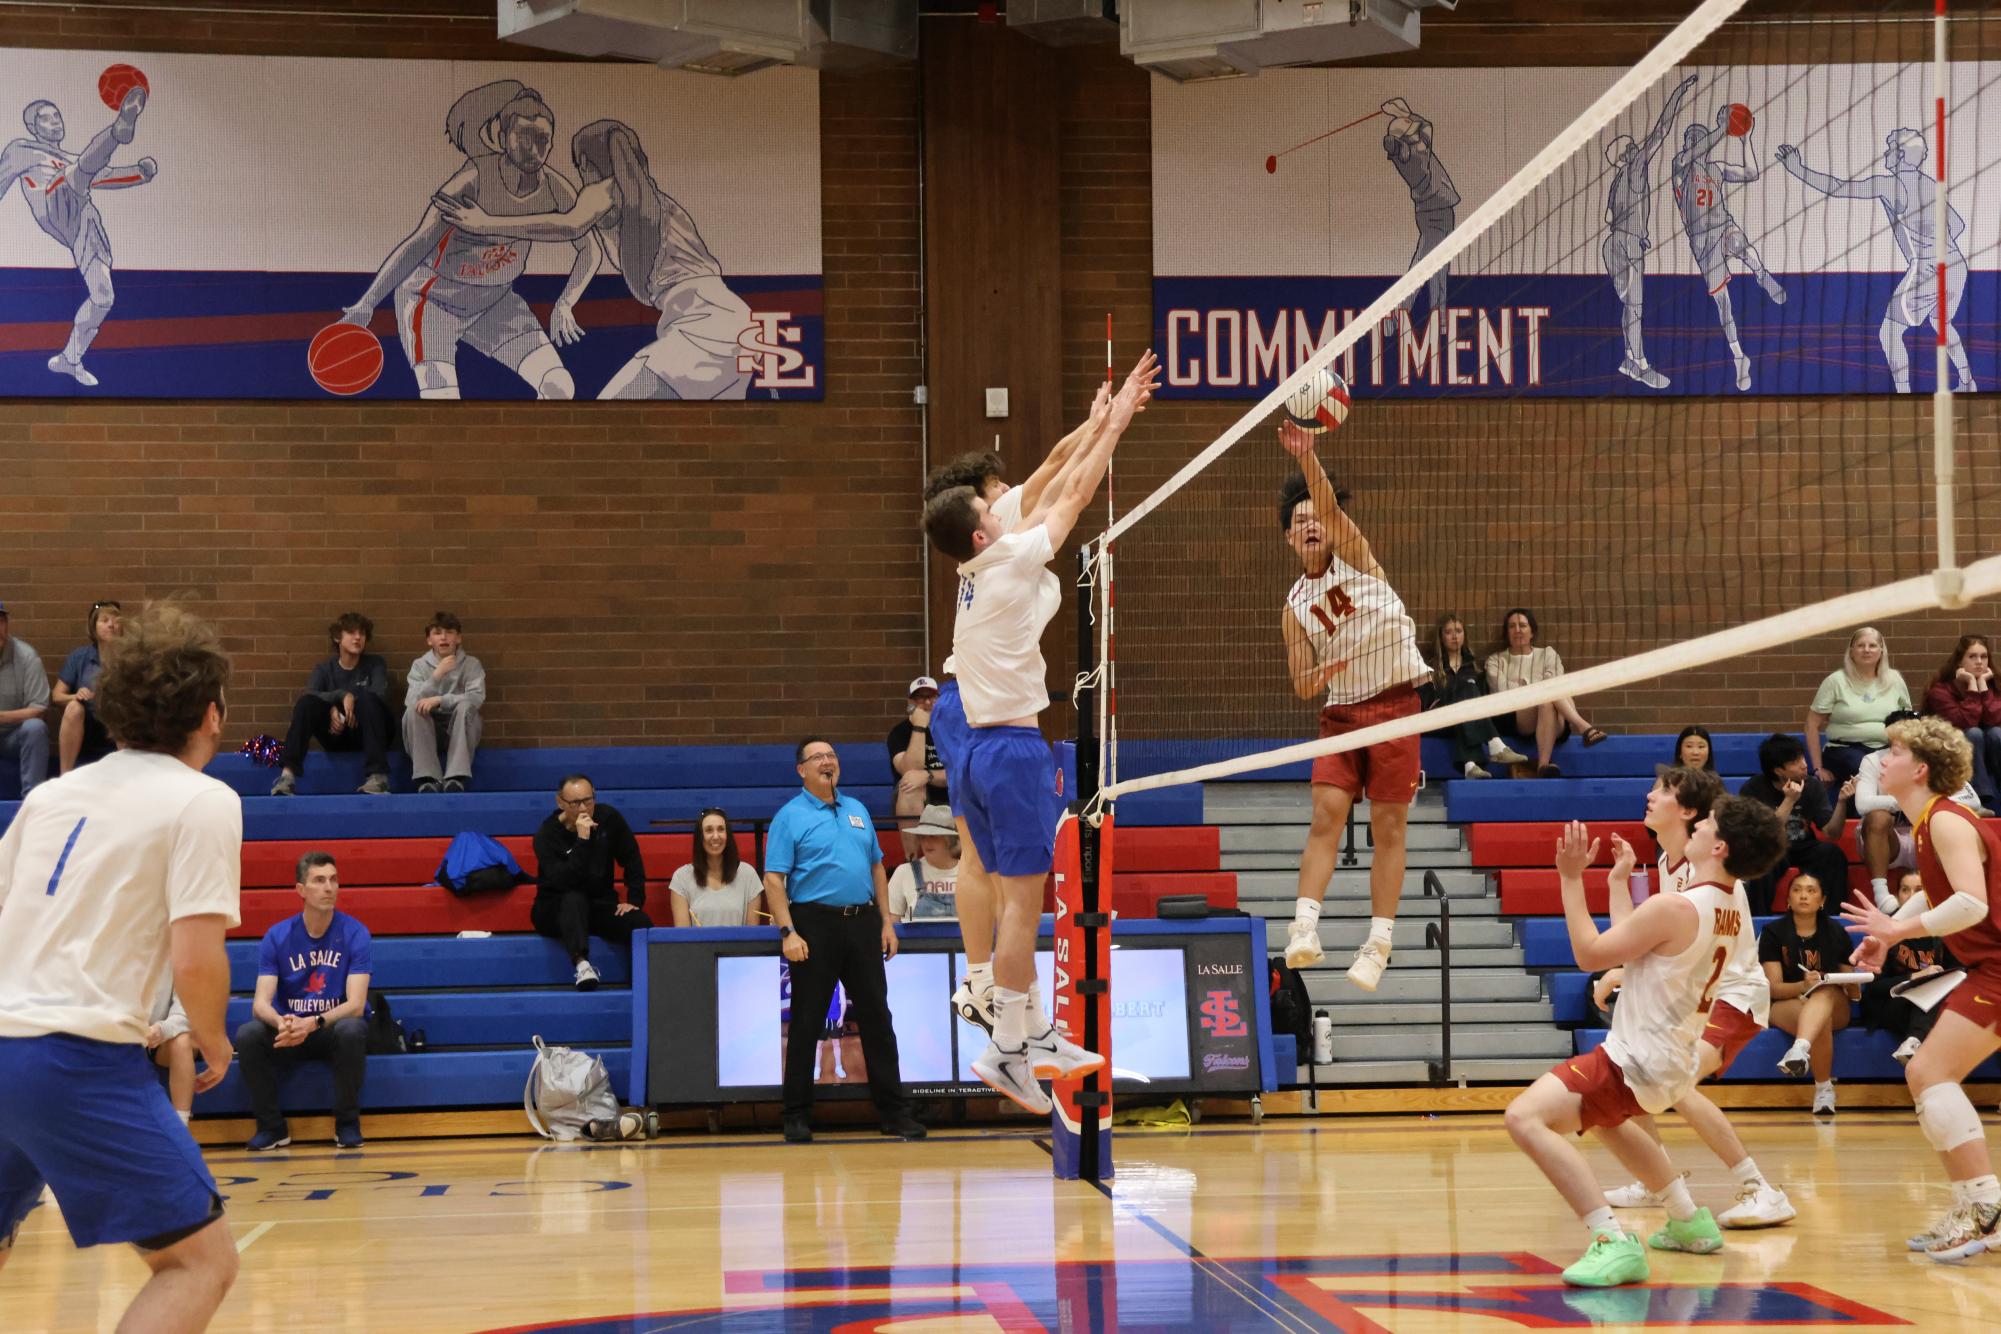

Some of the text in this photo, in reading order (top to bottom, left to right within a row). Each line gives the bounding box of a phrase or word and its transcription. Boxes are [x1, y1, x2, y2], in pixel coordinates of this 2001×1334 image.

[1696, 188, 1713, 207] 21
[1167, 308, 1550, 387] COMMITMENT
[1309, 585, 1356, 637] 14
[46, 816, 87, 896] 1
[1712, 908, 1741, 937] RAMS
[289, 949, 341, 972] LA SALLE
[1198, 964, 1243, 975] LA SALLE
[1055, 938, 1070, 1038] SALL
[1696, 946, 1727, 1013] 2
[1113, 1001, 1166, 1018] BERT
[1203, 1053, 1250, 1073] Falcons
